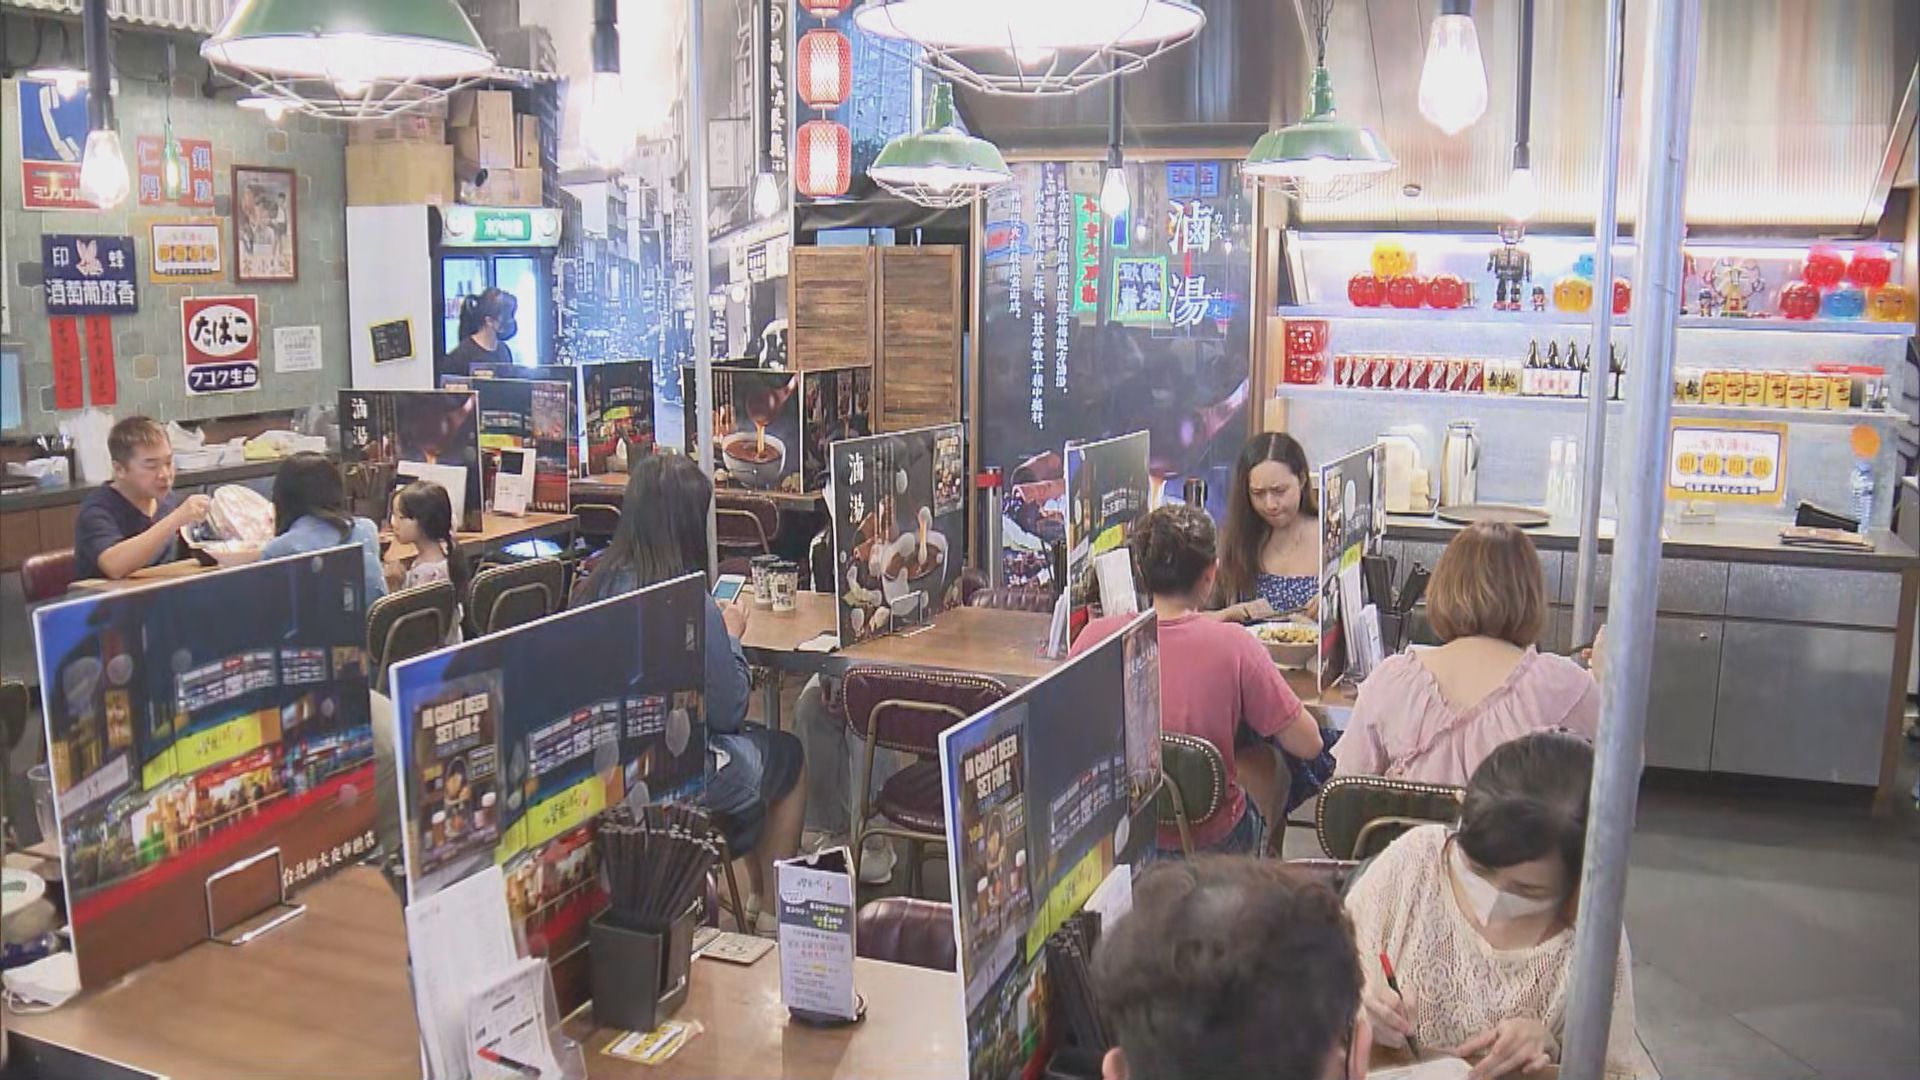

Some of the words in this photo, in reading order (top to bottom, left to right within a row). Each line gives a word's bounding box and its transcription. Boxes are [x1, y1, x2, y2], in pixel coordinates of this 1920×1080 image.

[52, 246, 69, 267] 印
[194, 312, 248, 346] たばこ
[191, 366, 256, 388] フコク生命
[998, 734, 1018, 762] BEER
[976, 772, 991, 800] SET
